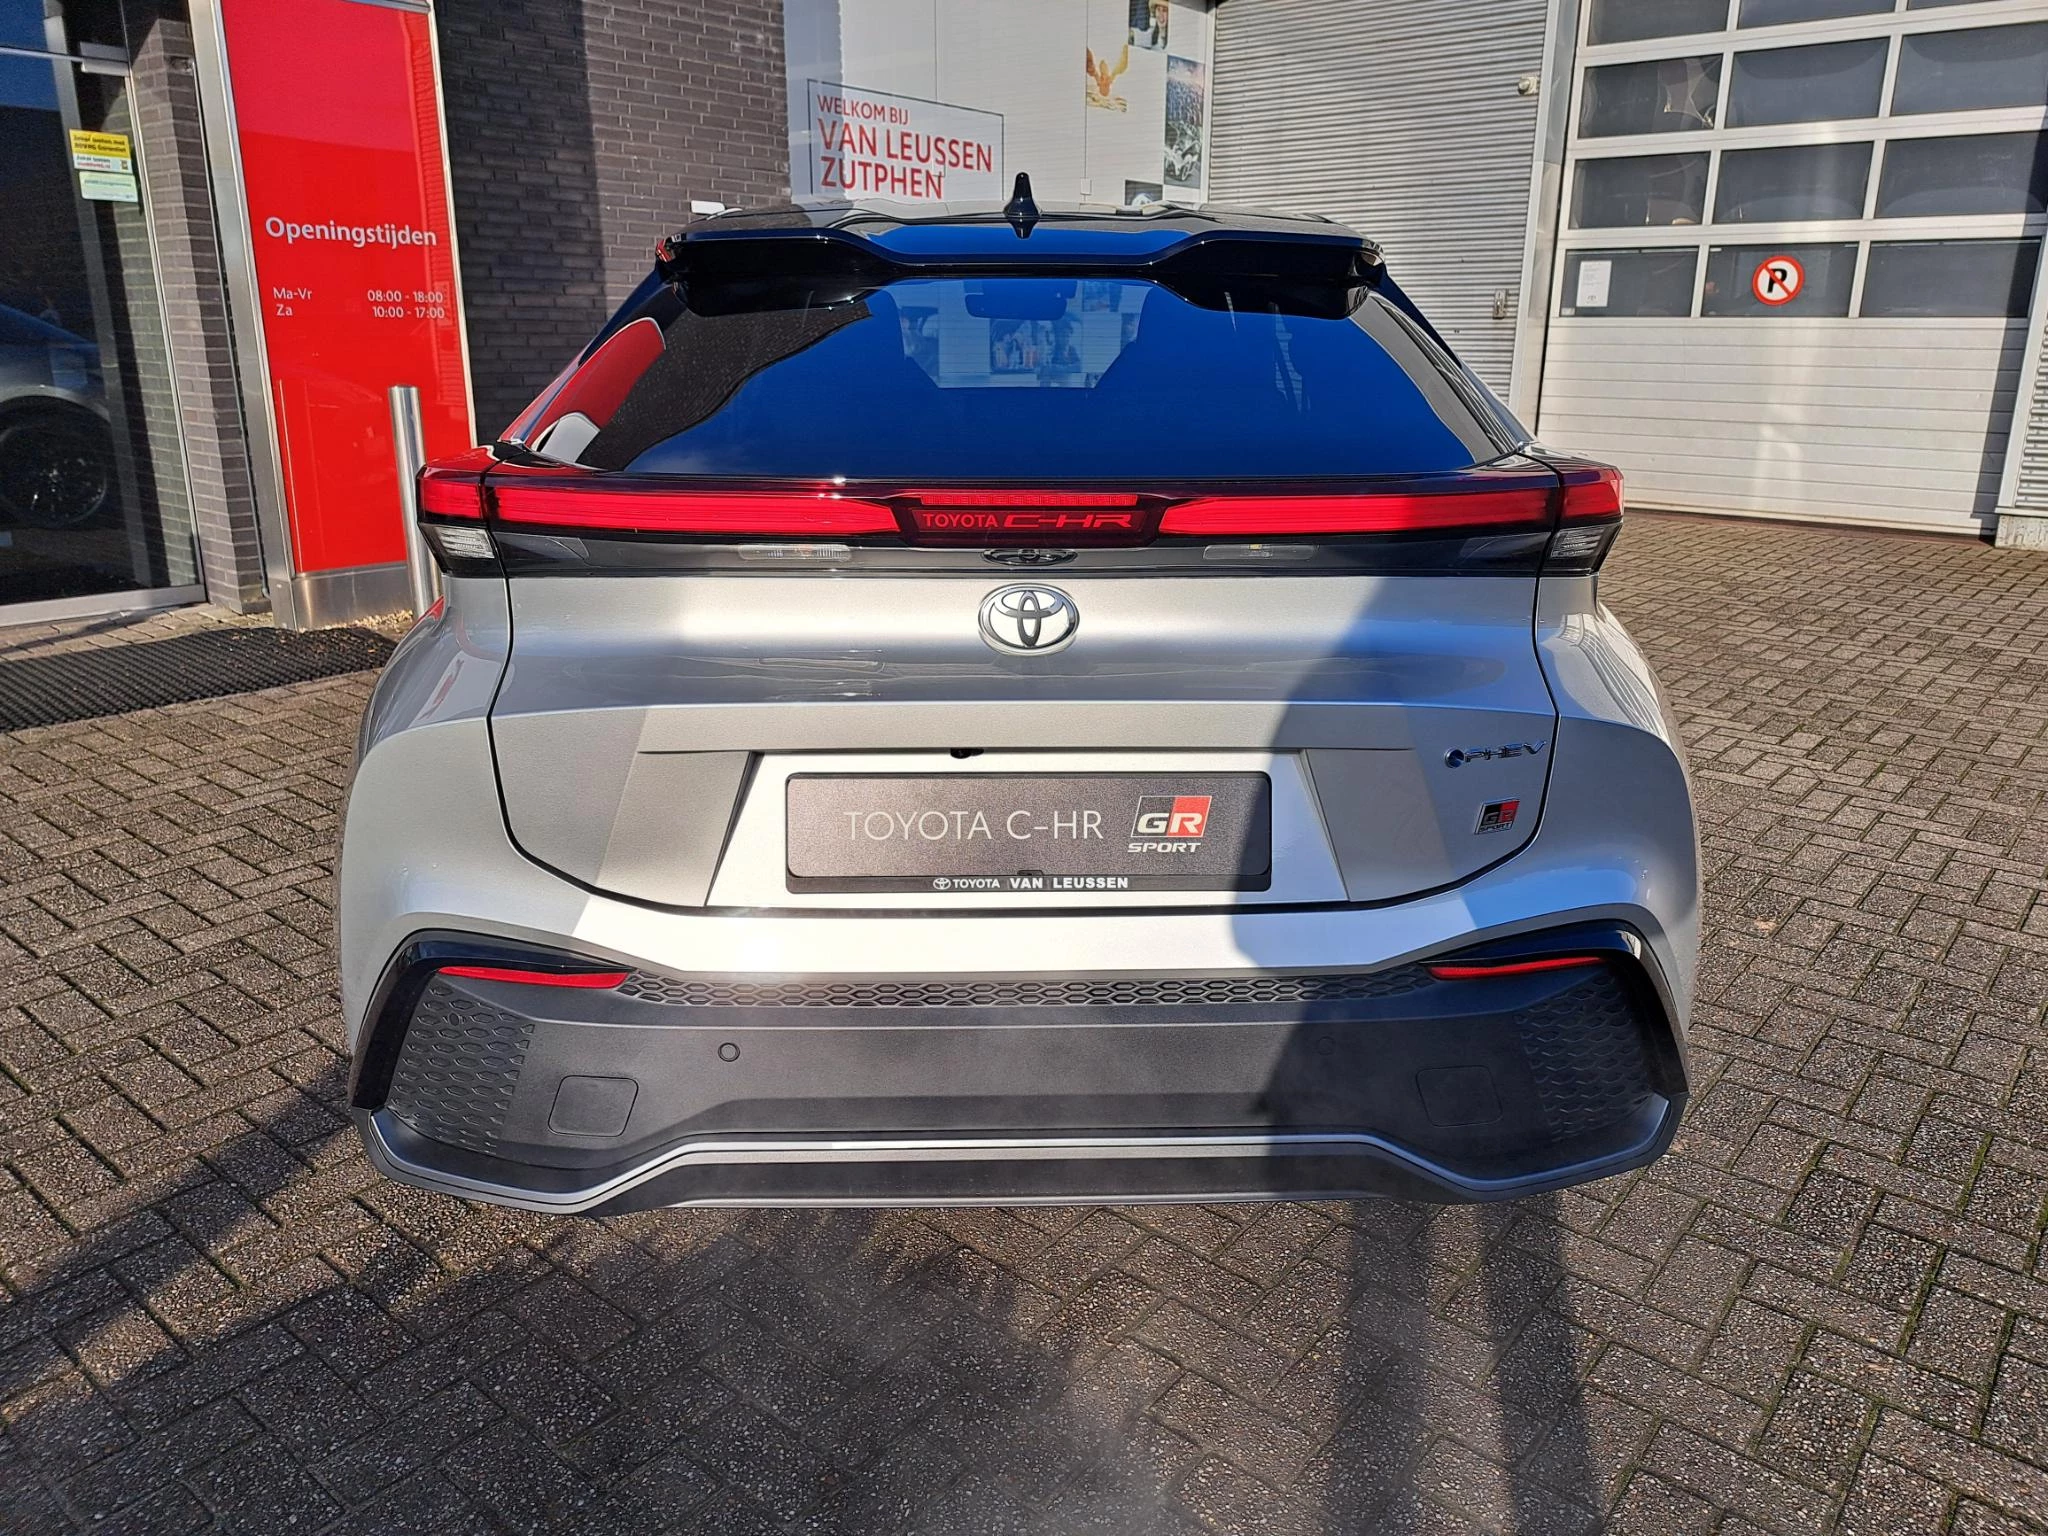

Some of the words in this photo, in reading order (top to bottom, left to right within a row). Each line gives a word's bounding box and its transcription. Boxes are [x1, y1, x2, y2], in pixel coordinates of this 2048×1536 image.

[817, 95, 886, 122] WELKOM
[890, 107, 909, 125] BIJ
[817, 118, 877, 157] VAN
[886, 129, 992, 173] LEUSSEN
[821, 156, 943, 199] ZUTPHEN
[265, 216, 437, 249] Openingstijden
[1766, 267, 1788, 294] P
[273, 287, 313, 300] Ma-Vr
[367, 290, 402, 302] 08:00
[413, 291, 443, 303] 18:00
[276, 304, 293, 316] Za
[373, 306, 404, 318] 10:00
[415, 306, 445, 319] 17:00
[922, 513, 999, 528] TOYOTA
[1003, 514, 1132, 528] C-HR
[1464, 741, 1547, 763] PHEV
[844, 810, 992, 841] TOYOTA
[1006, 810, 1104, 840] C-HR
[1137, 812, 1203, 834] GR
[1127, 842, 1201, 853] SPORT
[952, 878, 1001, 889] TOYOTA
[1010, 877, 1043, 889] VAN
[1053, 877, 1129, 889] LEUSSEN
